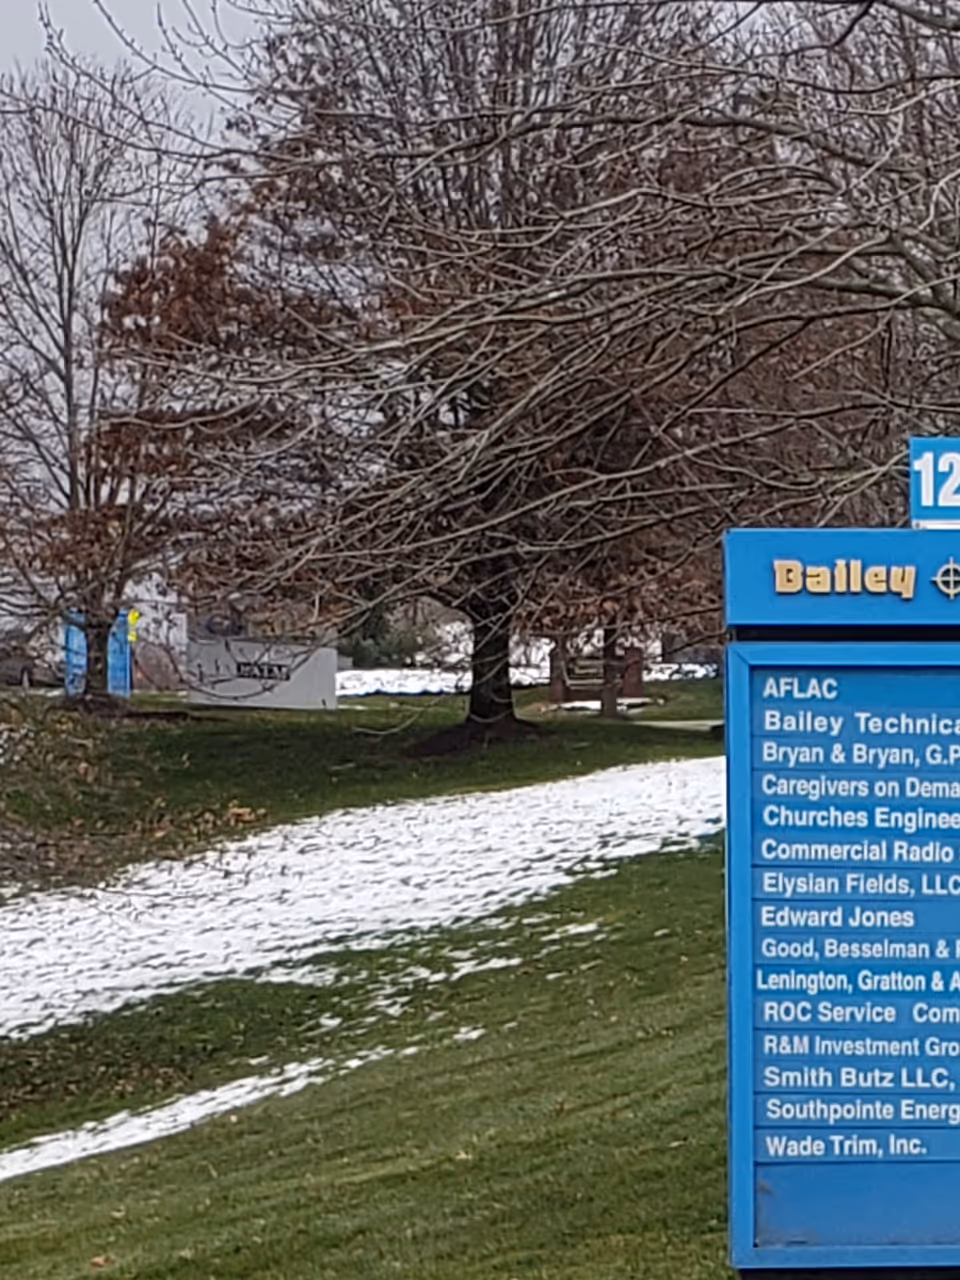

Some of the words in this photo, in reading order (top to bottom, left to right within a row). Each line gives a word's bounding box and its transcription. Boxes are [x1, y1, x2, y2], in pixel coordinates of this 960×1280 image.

[773, 559, 916, 599] Bailey
[763, 677, 838, 700] AFLAC
[764, 709, 844, 736] Bailey
[762, 741, 824, 768] Bryan
[830, 742, 846, 764] &
[852, 743, 921, 769] Bryan,
[761, 773, 869, 801] Caregivers
[874, 779, 900, 798] on
[763, 804, 868, 829] Churches
[761, 838, 887, 862] Commercial
[893, 840, 954, 864] Radio
[762, 871, 839, 898] Elysian
[846, 873, 916, 900] Fields,
[761, 905, 843, 928] Edward
[848, 906, 915, 928] Jones
[761, 937, 820, 963] Good,
[824, 938, 930, 960] Besselman
[935, 939, 950, 960] &
[757, 968, 853, 996] Lenington,
[857, 969, 926, 994] Gratton
[931, 970, 944, 993] &
[763, 1000, 812, 1023] ROC
[817, 1001, 897, 1023] Service
[763, 1034, 809, 1056] R&M
[815, 1035, 920, 1058] Investment
[763, 1066, 833, 1089] Smith
[840, 1067, 894, 1089] Butz
[901, 1067, 955, 1092] LLC,
[766, 1098, 895, 1126] Southpointe
[765, 1134, 825, 1158] Wade
[829, 1134, 883, 1160] Trim,
[888, 1134, 928, 1156] Inc.
